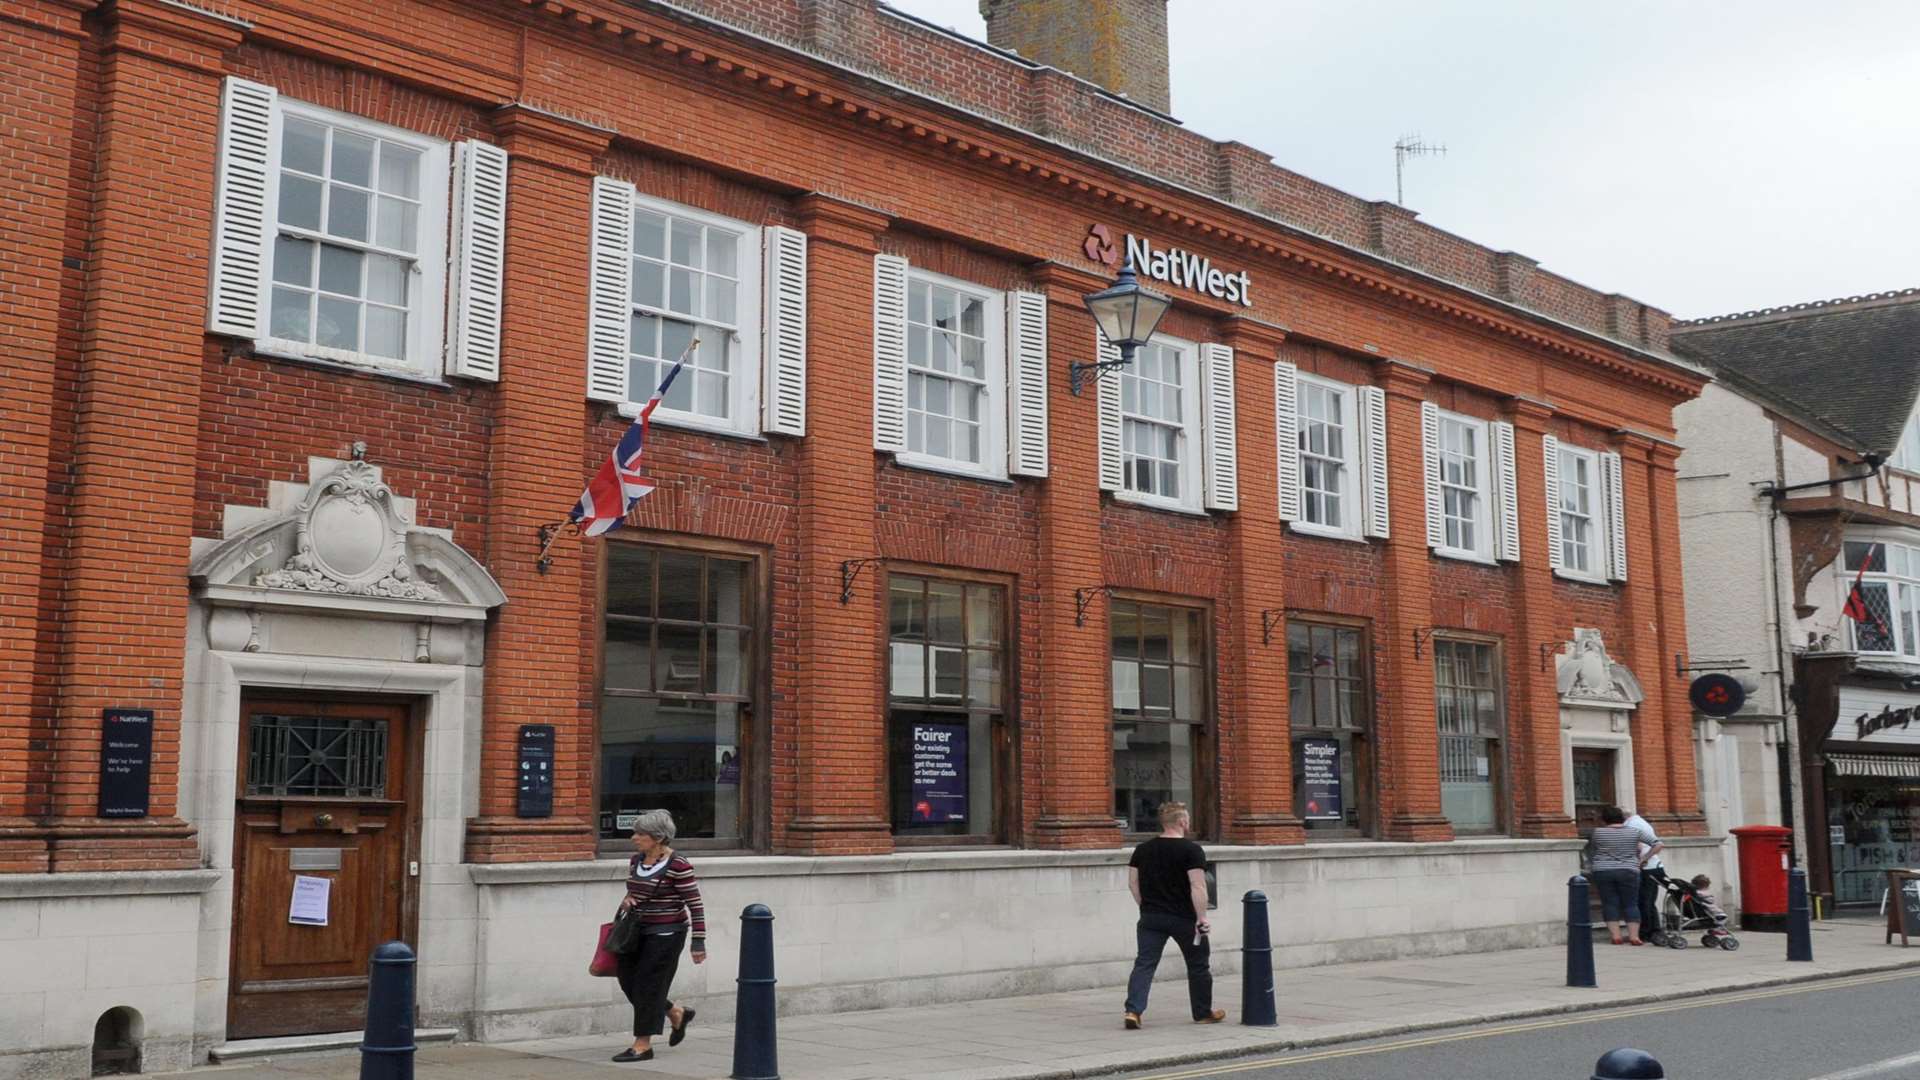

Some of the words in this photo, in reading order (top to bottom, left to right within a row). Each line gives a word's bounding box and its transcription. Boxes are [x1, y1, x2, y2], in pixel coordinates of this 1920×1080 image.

[1126, 233, 1252, 307] NatWest
[1856, 704, 1913, 740] Torbay
[914, 727, 952, 742] Fairer
[914, 743, 927, 751] Our
[927, 744, 950, 754] existing
[1304, 743, 1337, 757] Simpler
[914, 761, 925, 769] get
